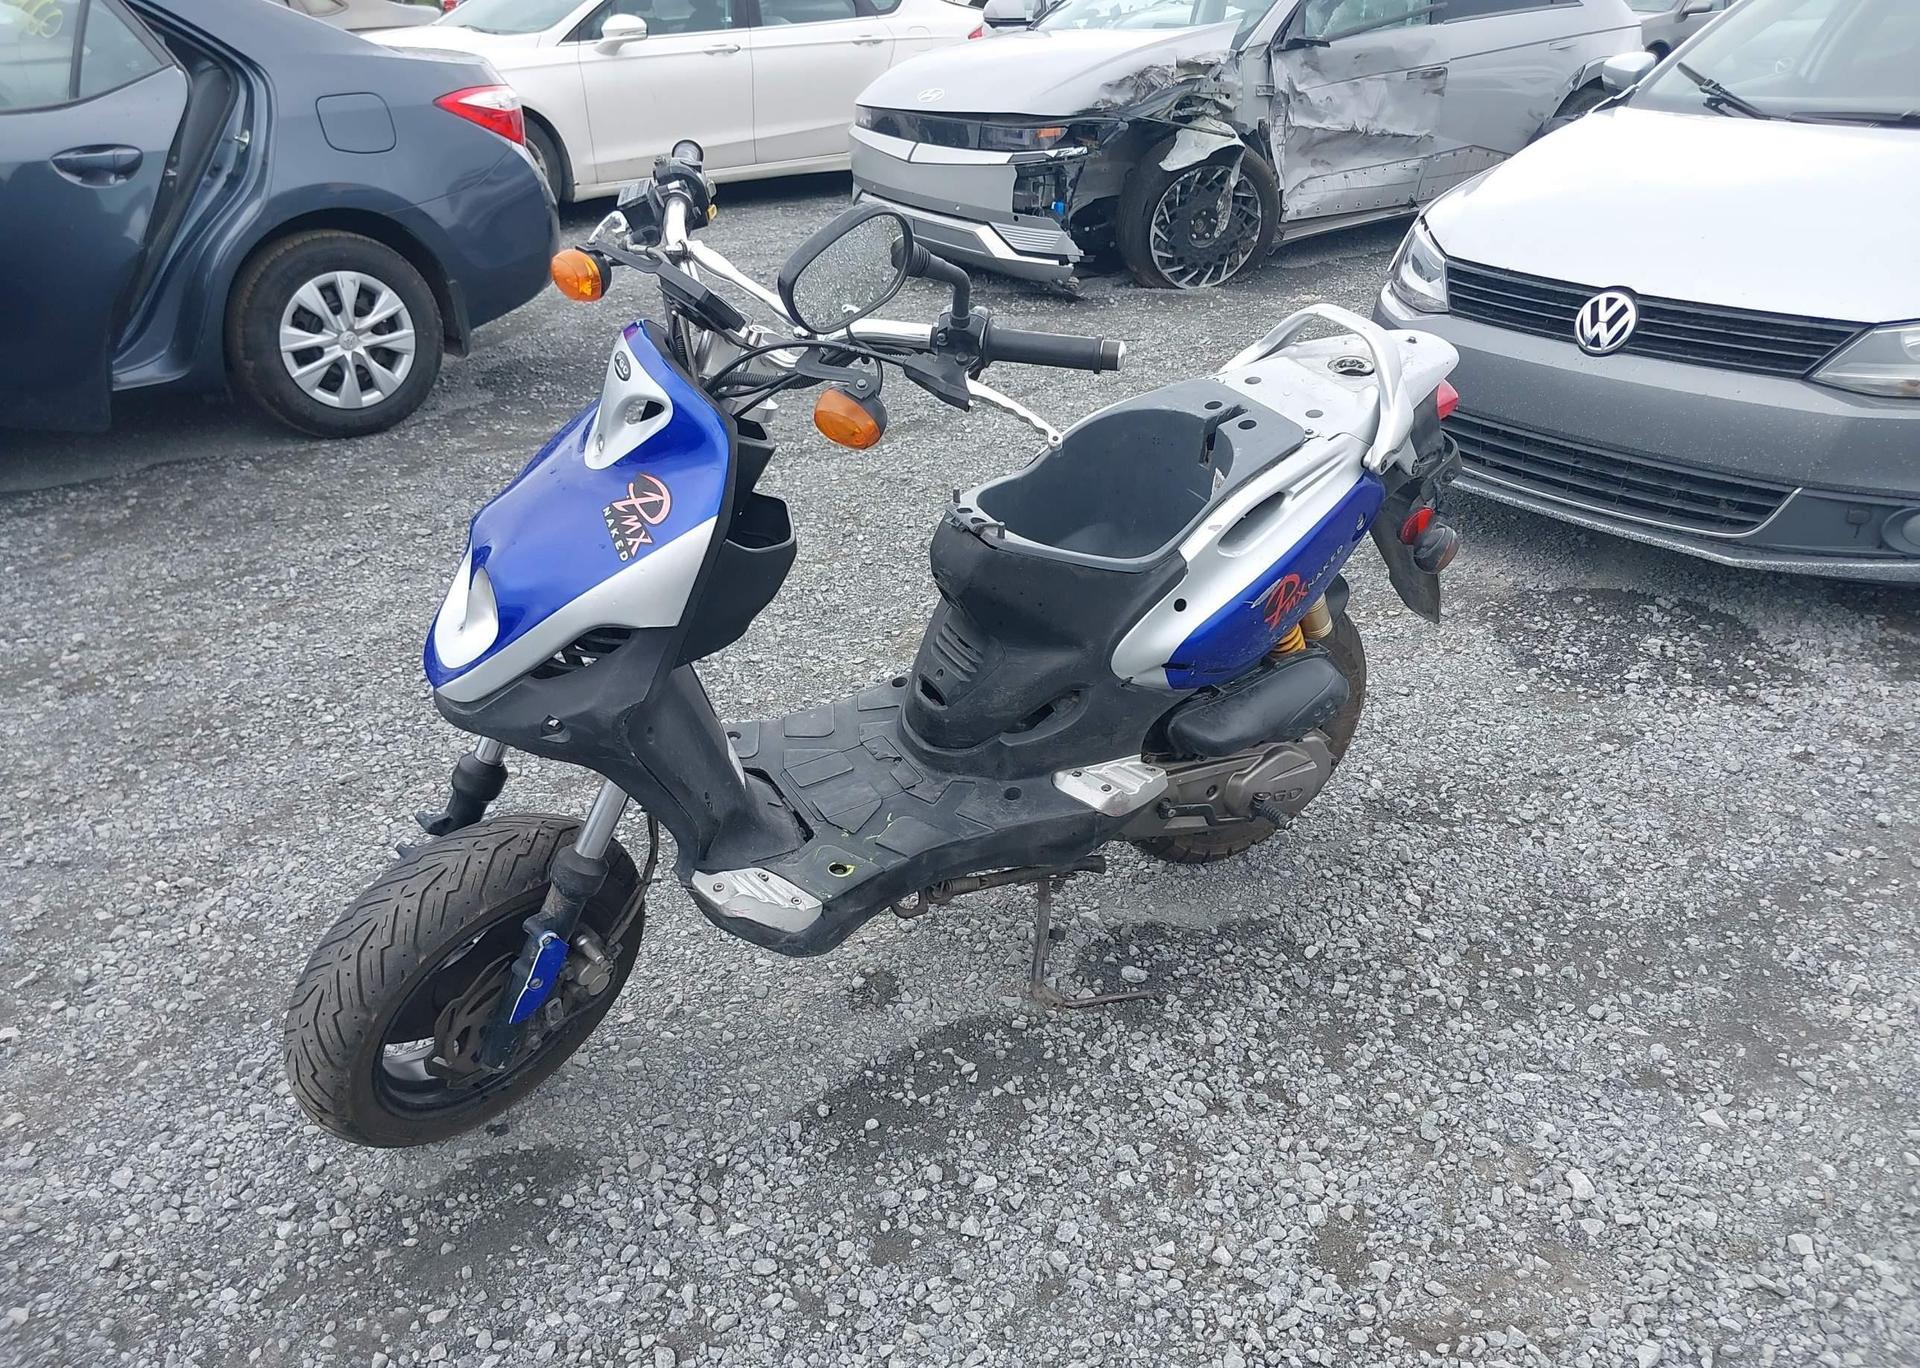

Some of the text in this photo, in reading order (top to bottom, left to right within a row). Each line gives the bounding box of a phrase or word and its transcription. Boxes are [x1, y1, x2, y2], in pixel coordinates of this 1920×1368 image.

[1577, 293, 1636, 351] VW
[602, 506, 629, 561] NAKED
[1307, 545, 1344, 590] NAKED
